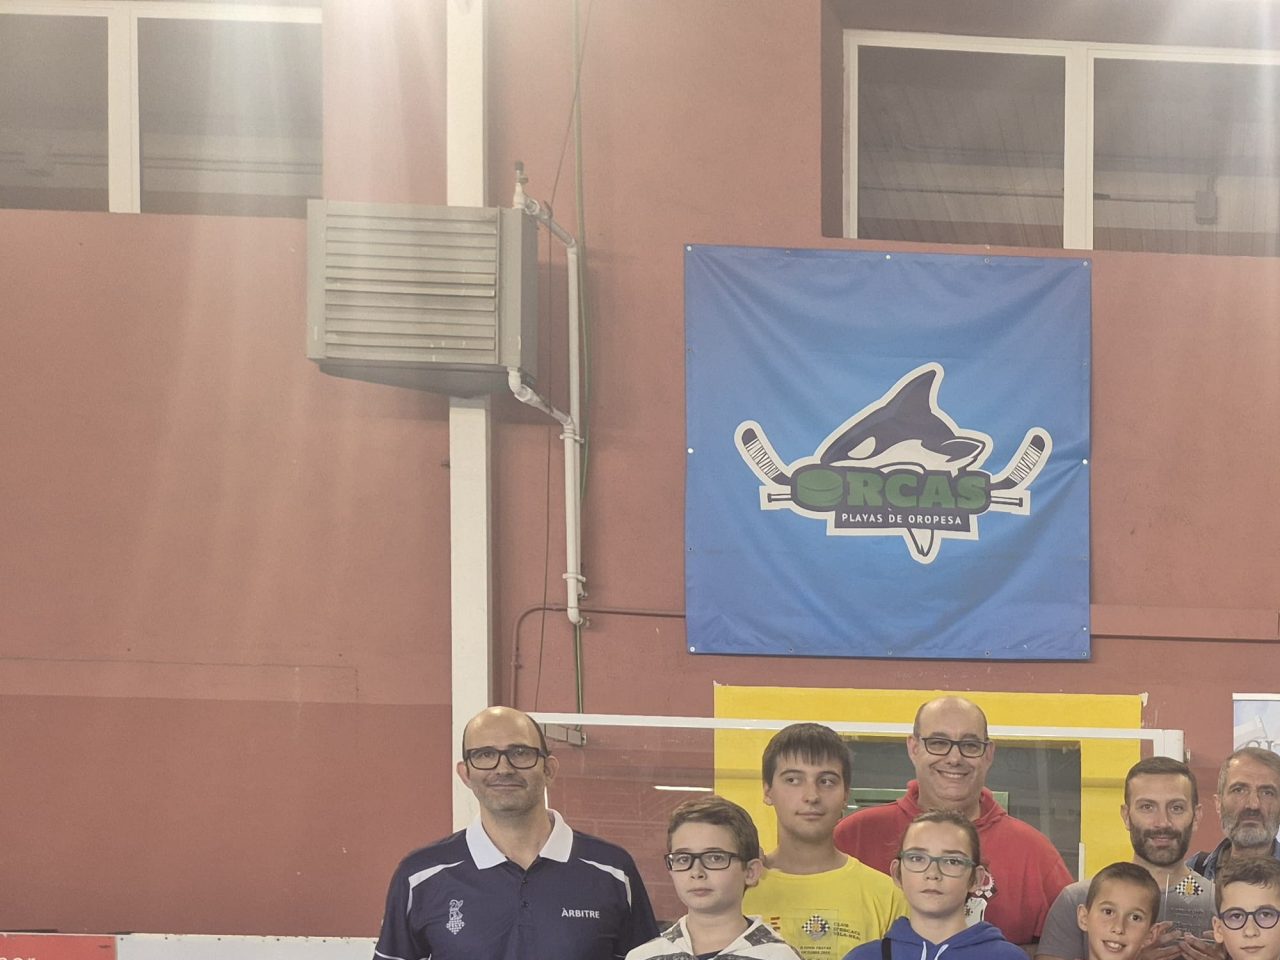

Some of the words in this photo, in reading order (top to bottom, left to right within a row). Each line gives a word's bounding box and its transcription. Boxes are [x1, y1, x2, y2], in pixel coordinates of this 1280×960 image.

[796, 469, 988, 509] ORCAS
[841, 513, 883, 523] PLAYAS
[888, 514, 903, 523] DE
[908, 514, 962, 525] OROPESA
